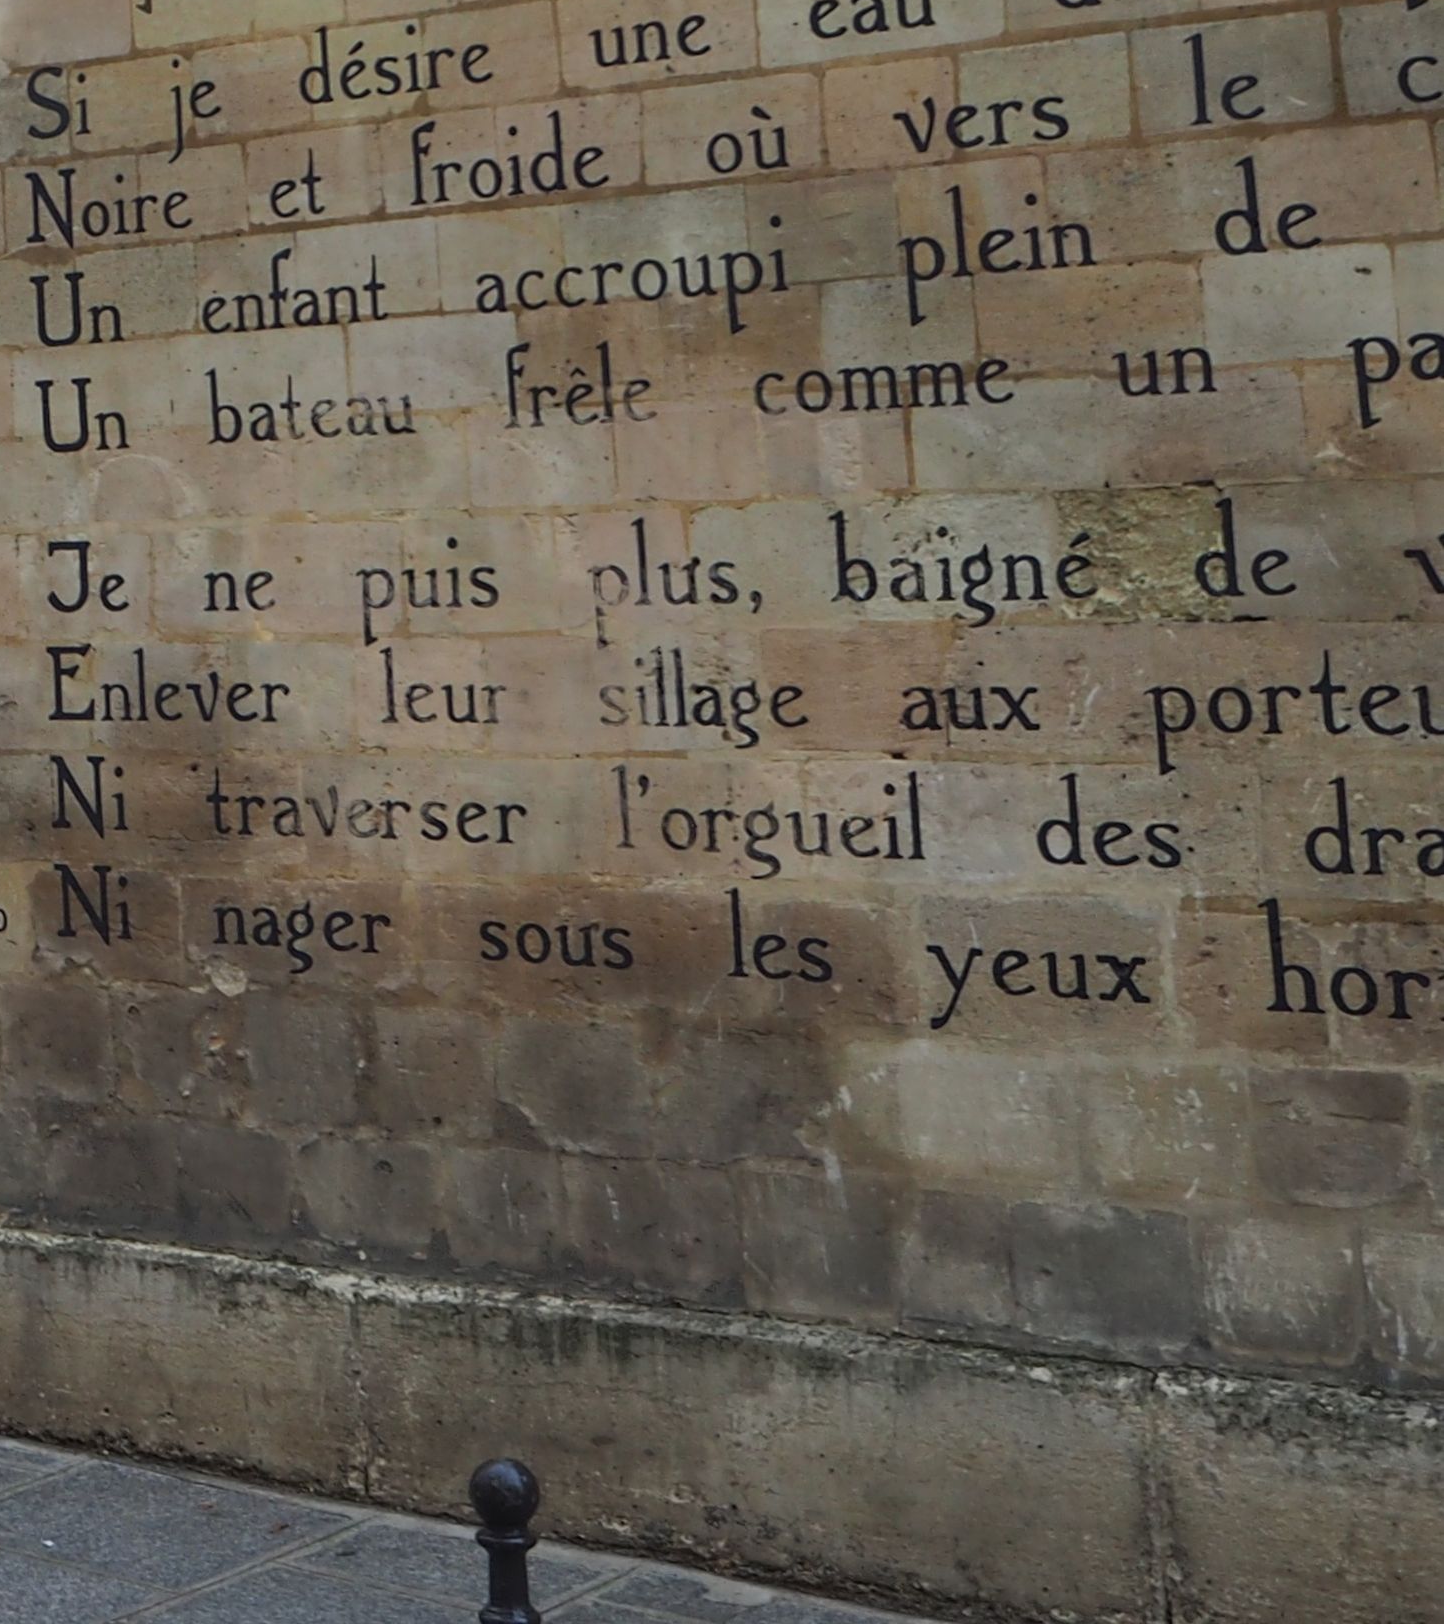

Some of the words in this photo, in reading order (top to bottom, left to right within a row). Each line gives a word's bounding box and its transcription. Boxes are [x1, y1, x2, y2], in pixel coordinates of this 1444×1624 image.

[25, 64, 92, 142] Si
[168, 58, 223, 164] je
[298, 22, 495, 107] désire
[591, 10, 712, 69] une
[25, 168, 193, 248] Noire
[270, 148, 326, 219] et
[411, 109, 610, 208] froide
[707, 105, 790, 176] où
[895, 94, 1070, 154] vers
[1184, 33, 1265, 127] le
[29, 273, 123, 348] Un
[202, 246, 388, 334] enfant
[475, 215, 790, 334] accroupi
[899, 185, 1096, 326] plein
[1215, 156, 1322, 257] de
[35, 377, 130, 453] Un
[208, 368, 417, 444] bateau
[505, 341, 657, 428] frêle
[754, 352, 1015, 416] comme
[1114, 344, 1217, 399] un
[46, 540, 129, 613] Je
[203, 567, 275, 612] ne
[355, 537, 501, 647] puis
[588, 517, 763, 647] plus,
[829, 511, 1099, 628] baigné
[1194, 498, 1298, 598] de
[47, 642, 290, 722] Enlever
[380, 646, 507, 726] leur
[597, 646, 808, 750] sillage
[900, 682, 1041, 732] aux
[50, 755, 129, 839] Ni
[206, 766, 527, 844] traverser
[612, 765, 926, 880] l'orgueil
[1036, 771, 1183, 867] des
[57, 864, 133, 944] Ni
[213, 899, 391, 975] nager
[478, 916, 634, 970] sous
[726, 888, 833, 982] les
[926, 945, 1152, 1031] yeux
